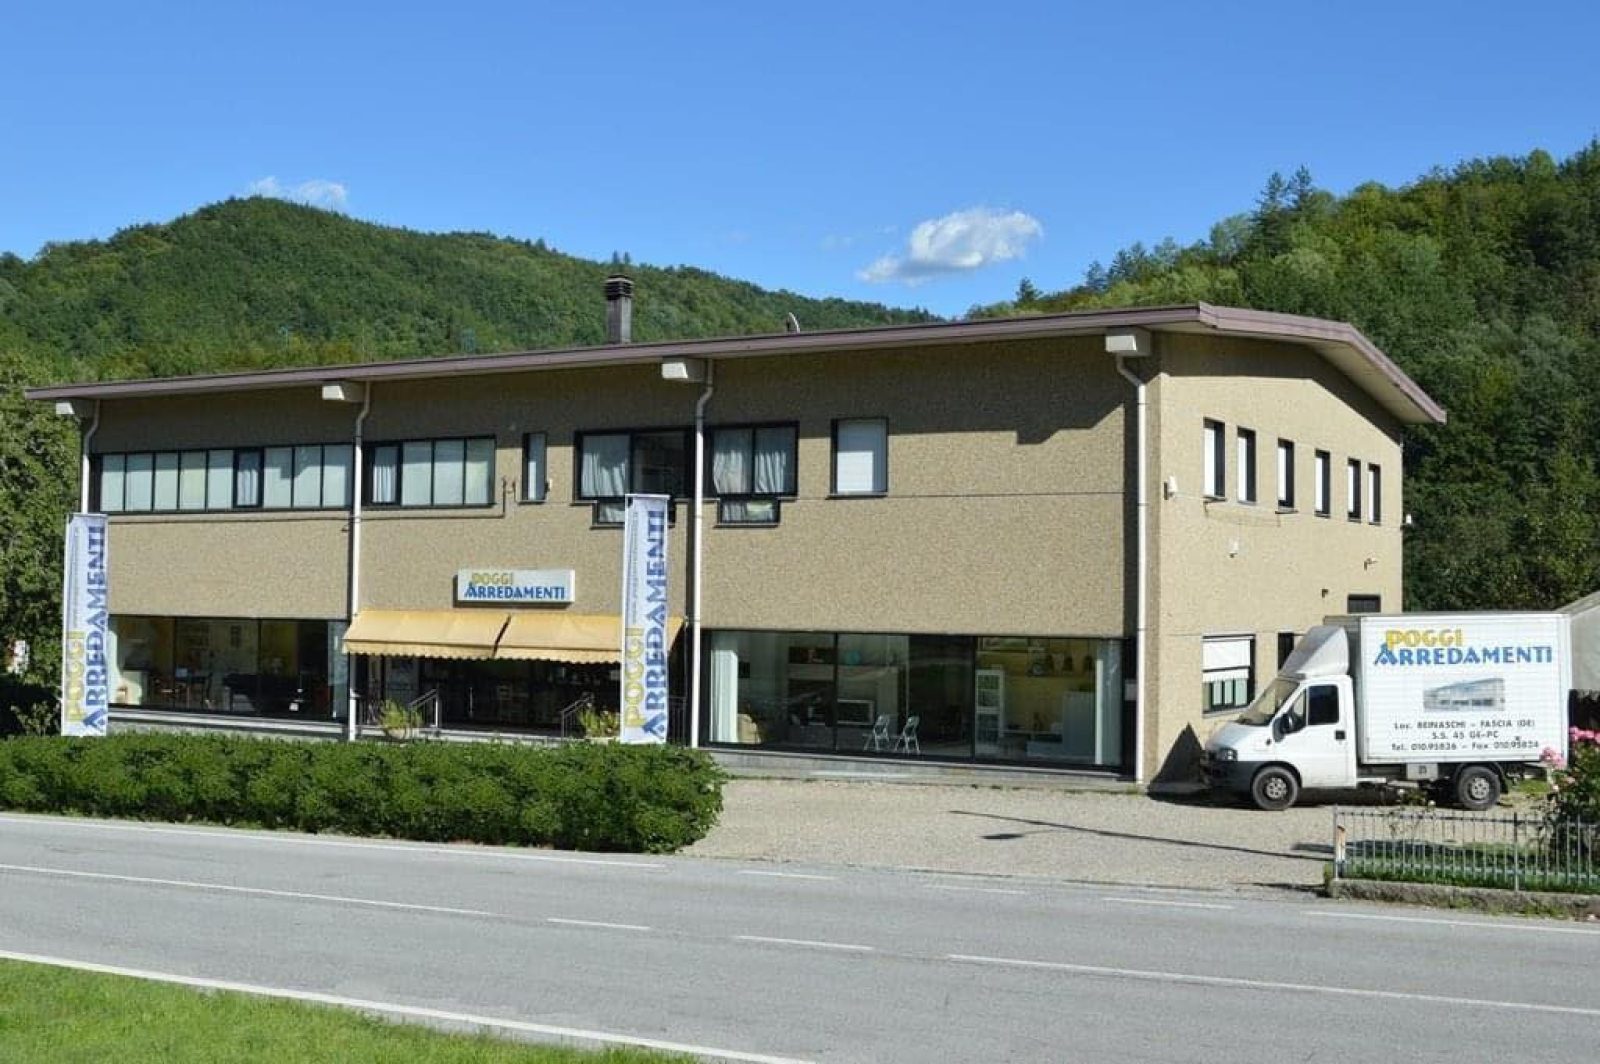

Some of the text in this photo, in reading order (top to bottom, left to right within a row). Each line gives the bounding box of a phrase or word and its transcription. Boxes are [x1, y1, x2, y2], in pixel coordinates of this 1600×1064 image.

[464, 581, 565, 599] ARREDAMENTI
[472, 573, 513, 585] POGGI
[83, 526, 106, 730] ARREDAMENTI
[643, 511, 667, 737] ARREDAMENTI
[1385, 629, 1463, 649] POGGI
[67, 630, 85, 722] POGGI
[625, 628, 645, 727] POGGI
[1374, 643, 1552, 665] ARREDAMENTI
